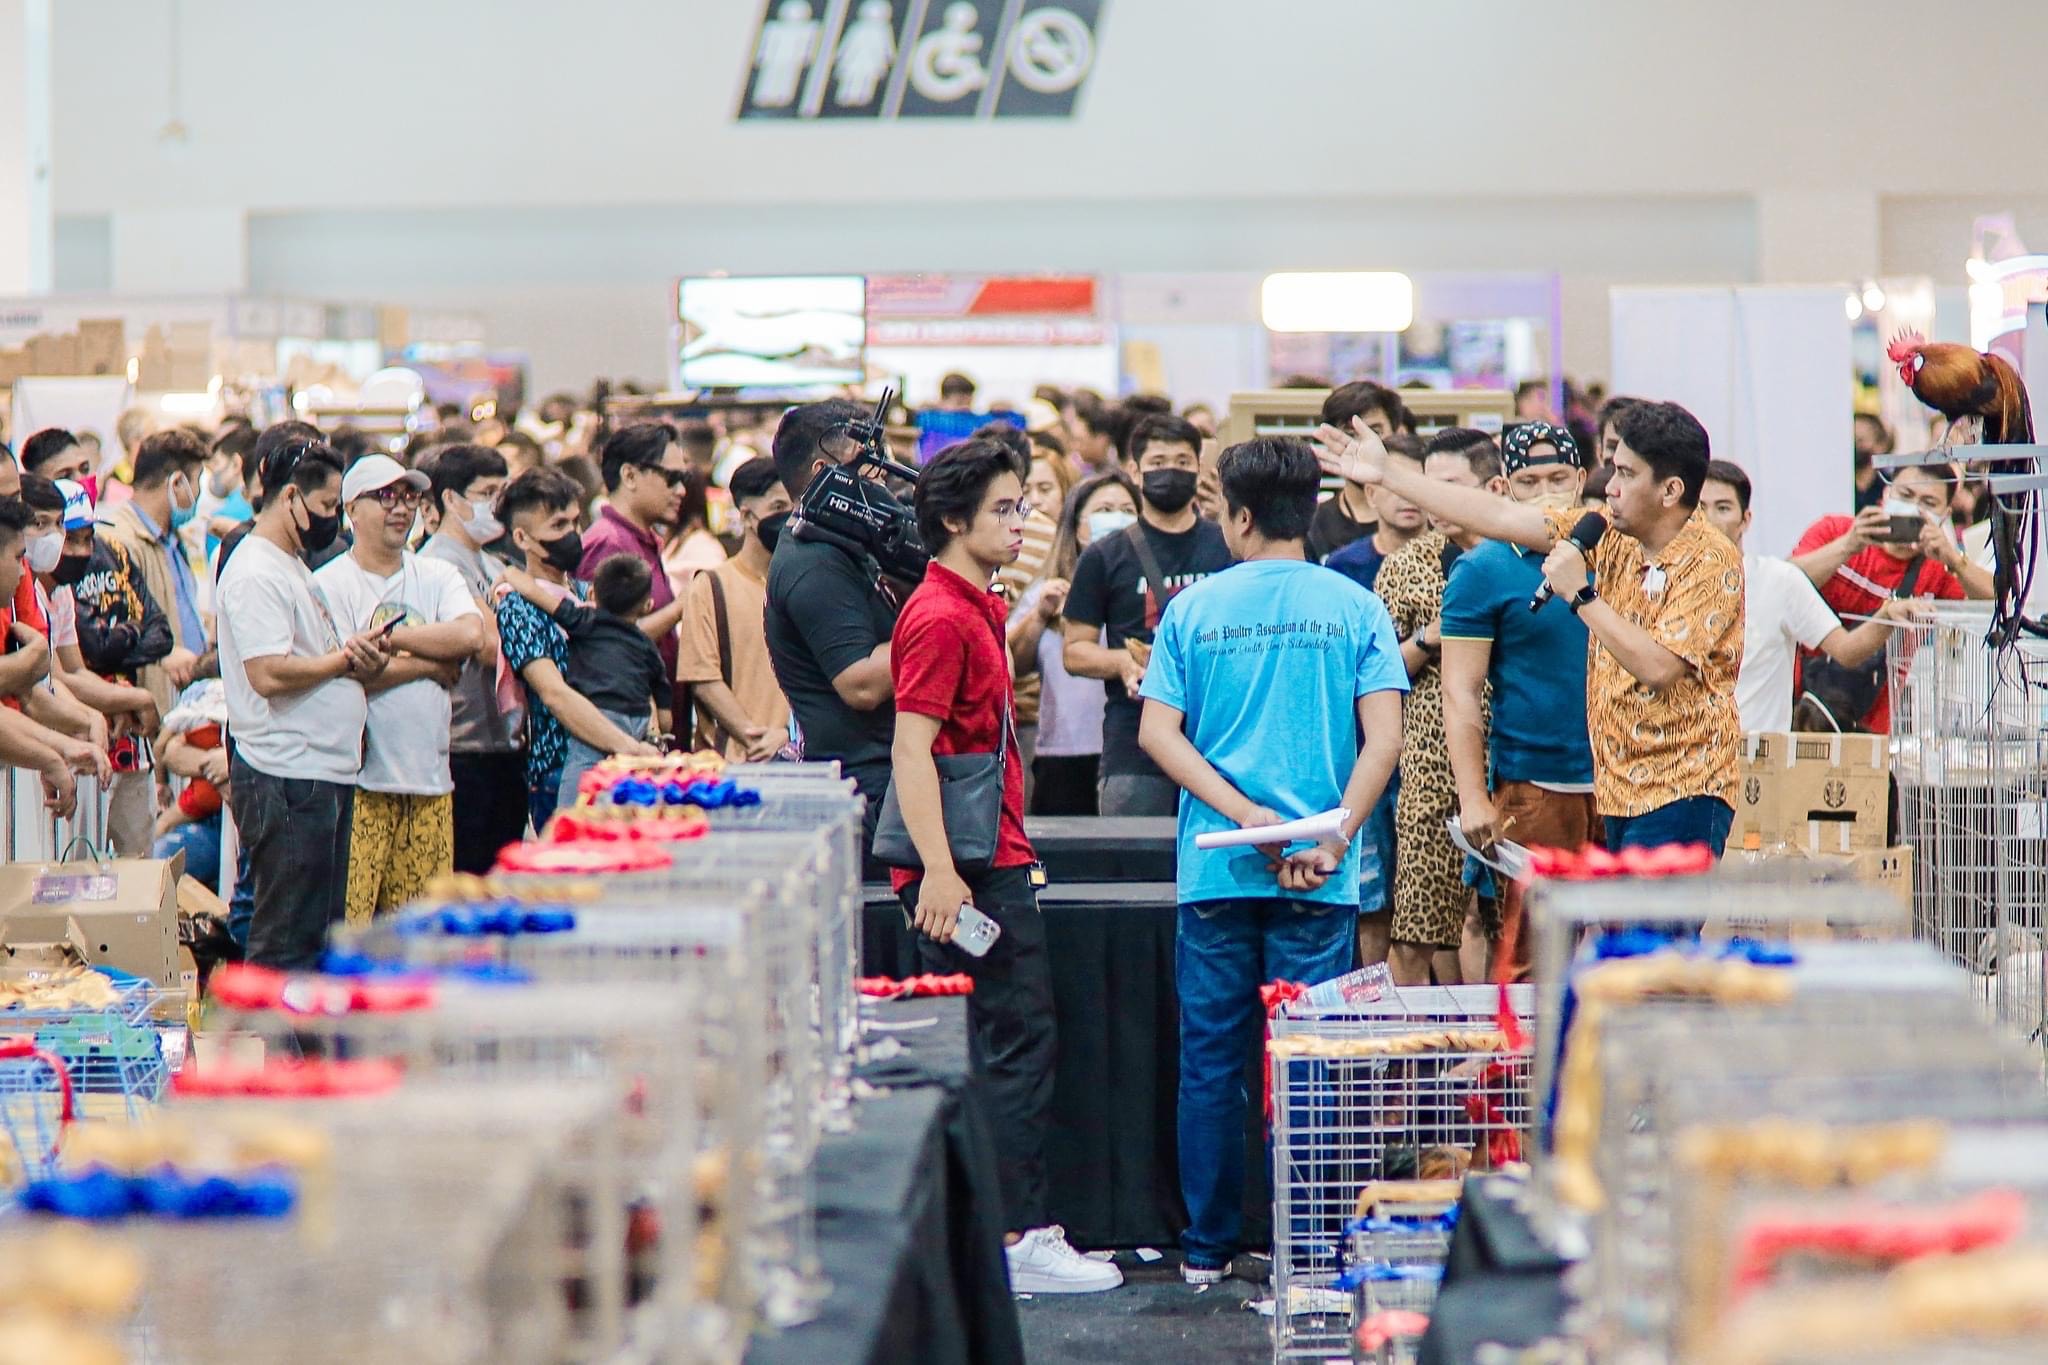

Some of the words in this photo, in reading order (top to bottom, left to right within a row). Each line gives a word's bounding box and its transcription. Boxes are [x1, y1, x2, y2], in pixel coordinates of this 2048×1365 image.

[834, 473, 854, 485] SONY
[829, 496, 849, 512] HD
[1195, 627, 1219, 644] South
[1222, 625, 1253, 641] Poultry
[1256, 622, 1297, 637] Association
[1299, 618, 1308, 633] of
[1310, 619, 1322, 634] the
